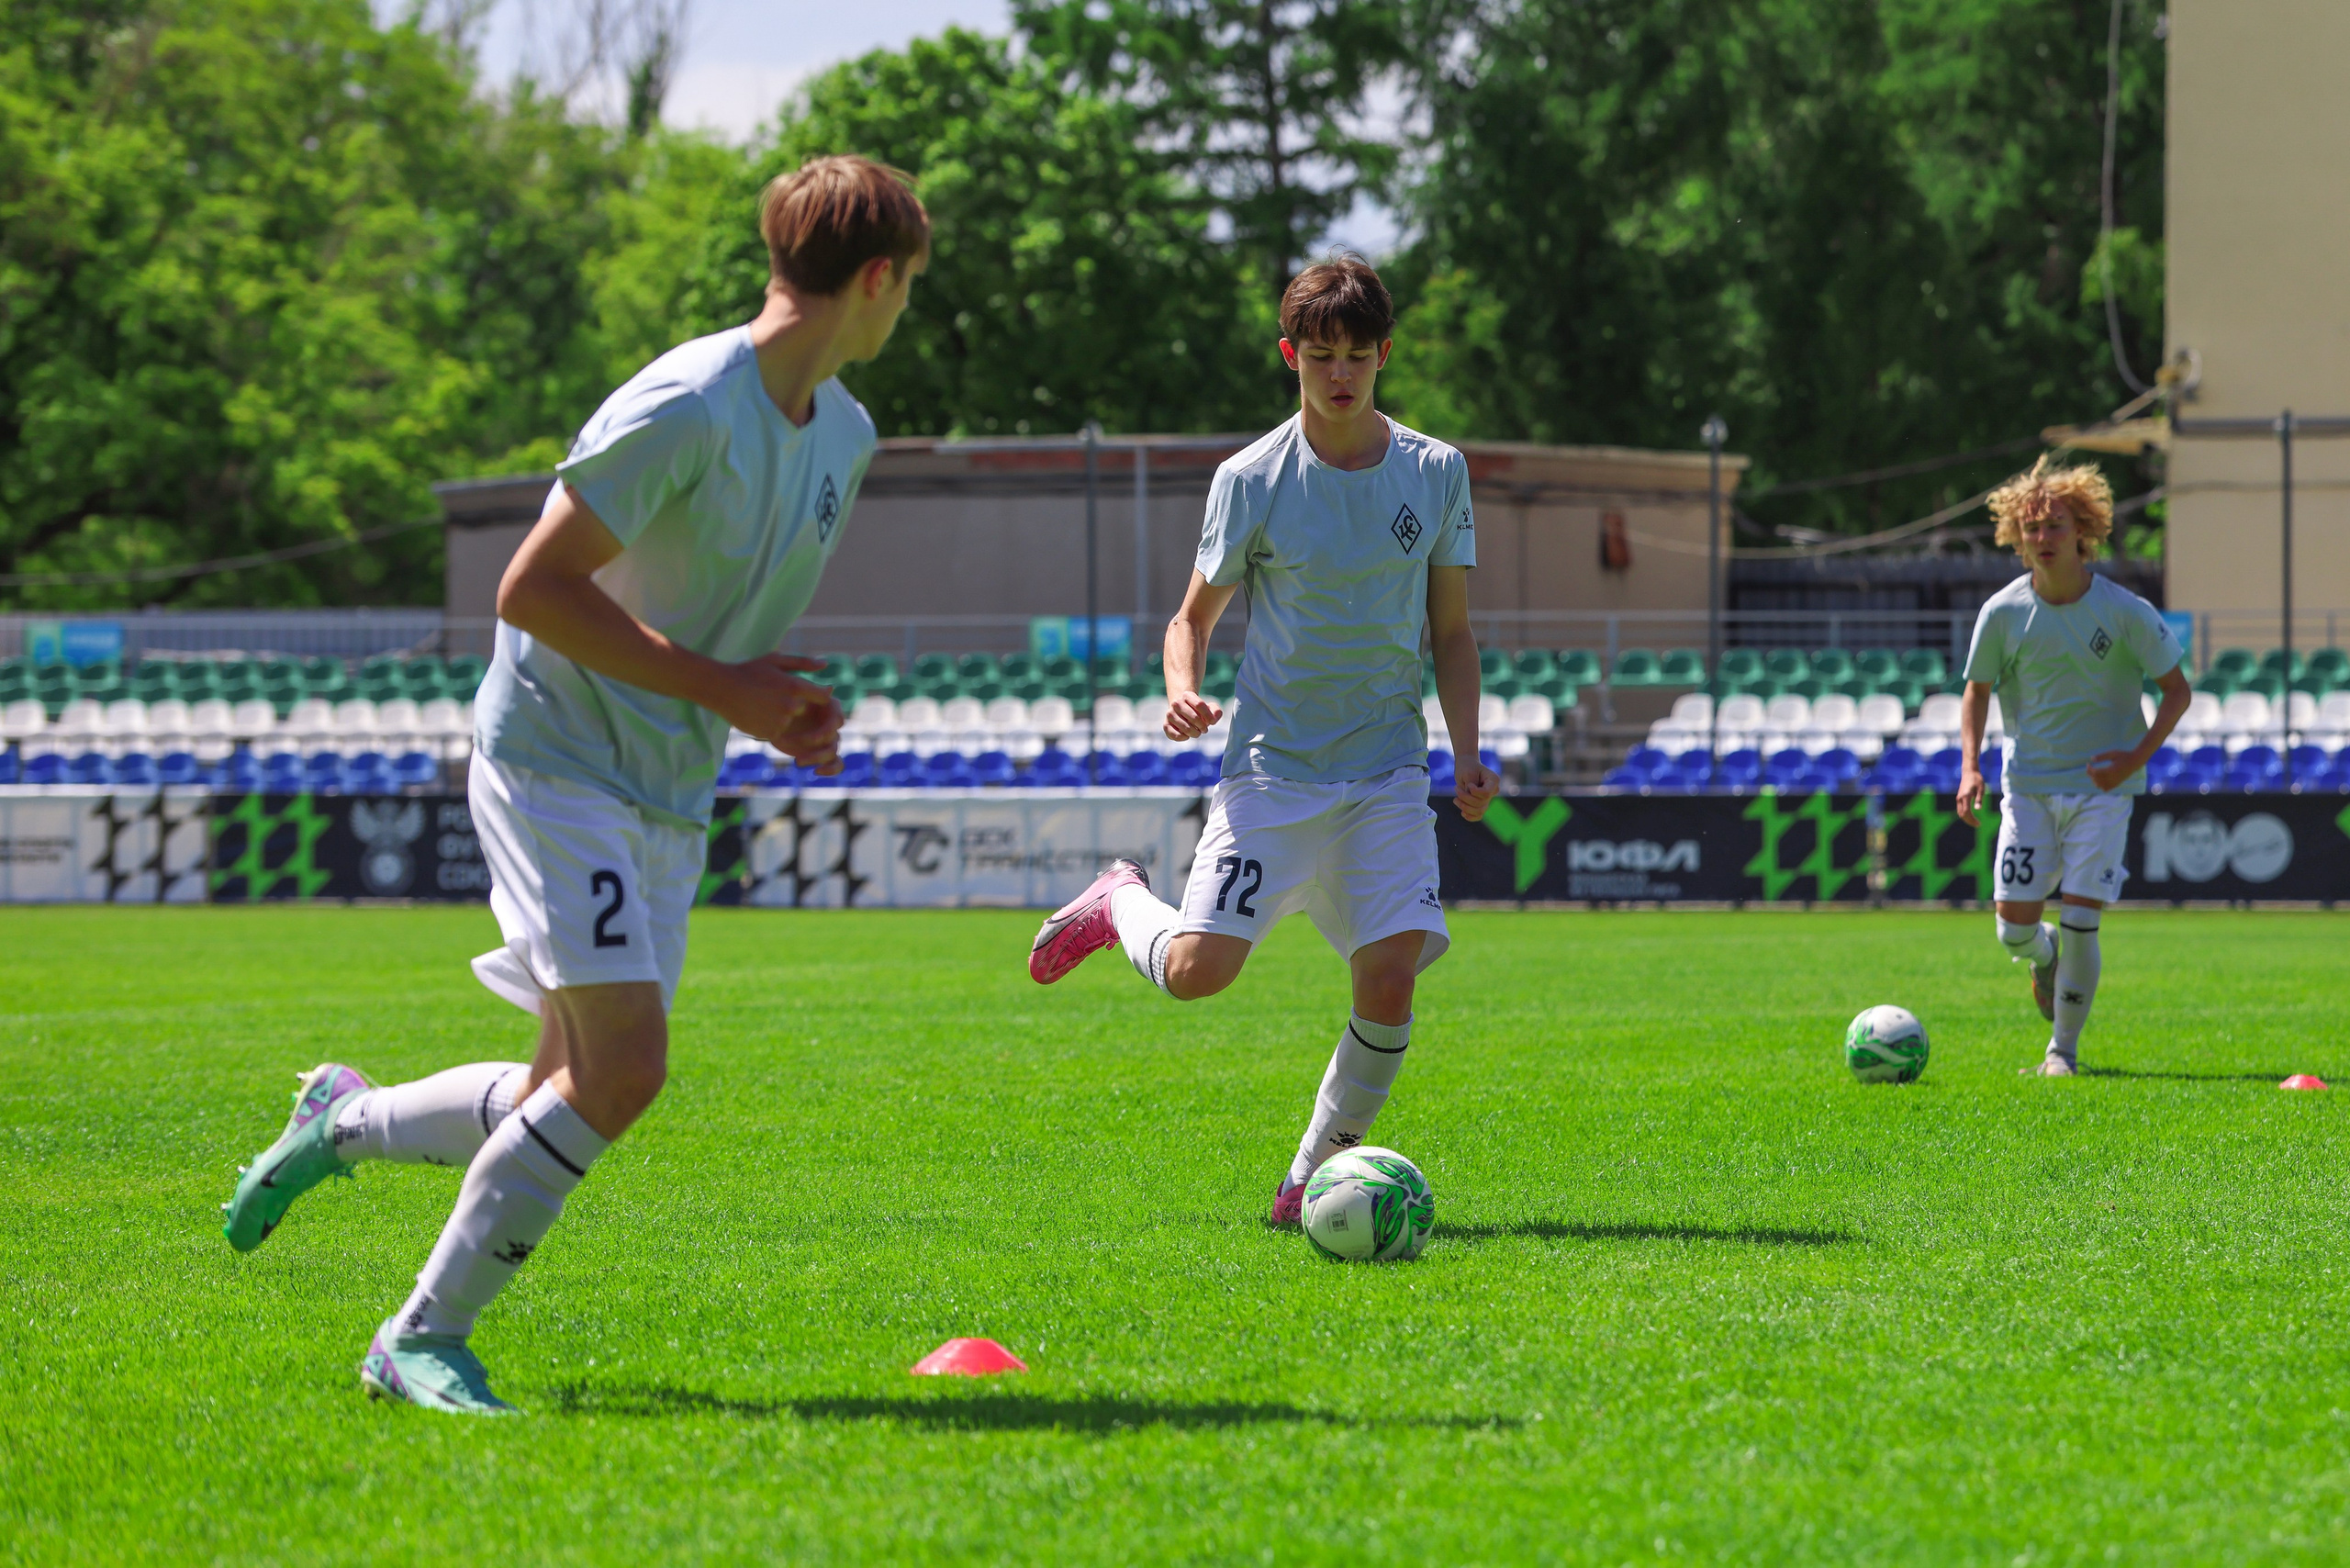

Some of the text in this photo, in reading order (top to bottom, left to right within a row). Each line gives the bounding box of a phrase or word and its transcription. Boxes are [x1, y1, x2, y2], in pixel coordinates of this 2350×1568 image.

[1568, 839, 1700, 871] ЮФЛ
[2002, 846, 2034, 885] 63
[590, 869, 628, 947] 2
[1215, 857, 1262, 918] 72
